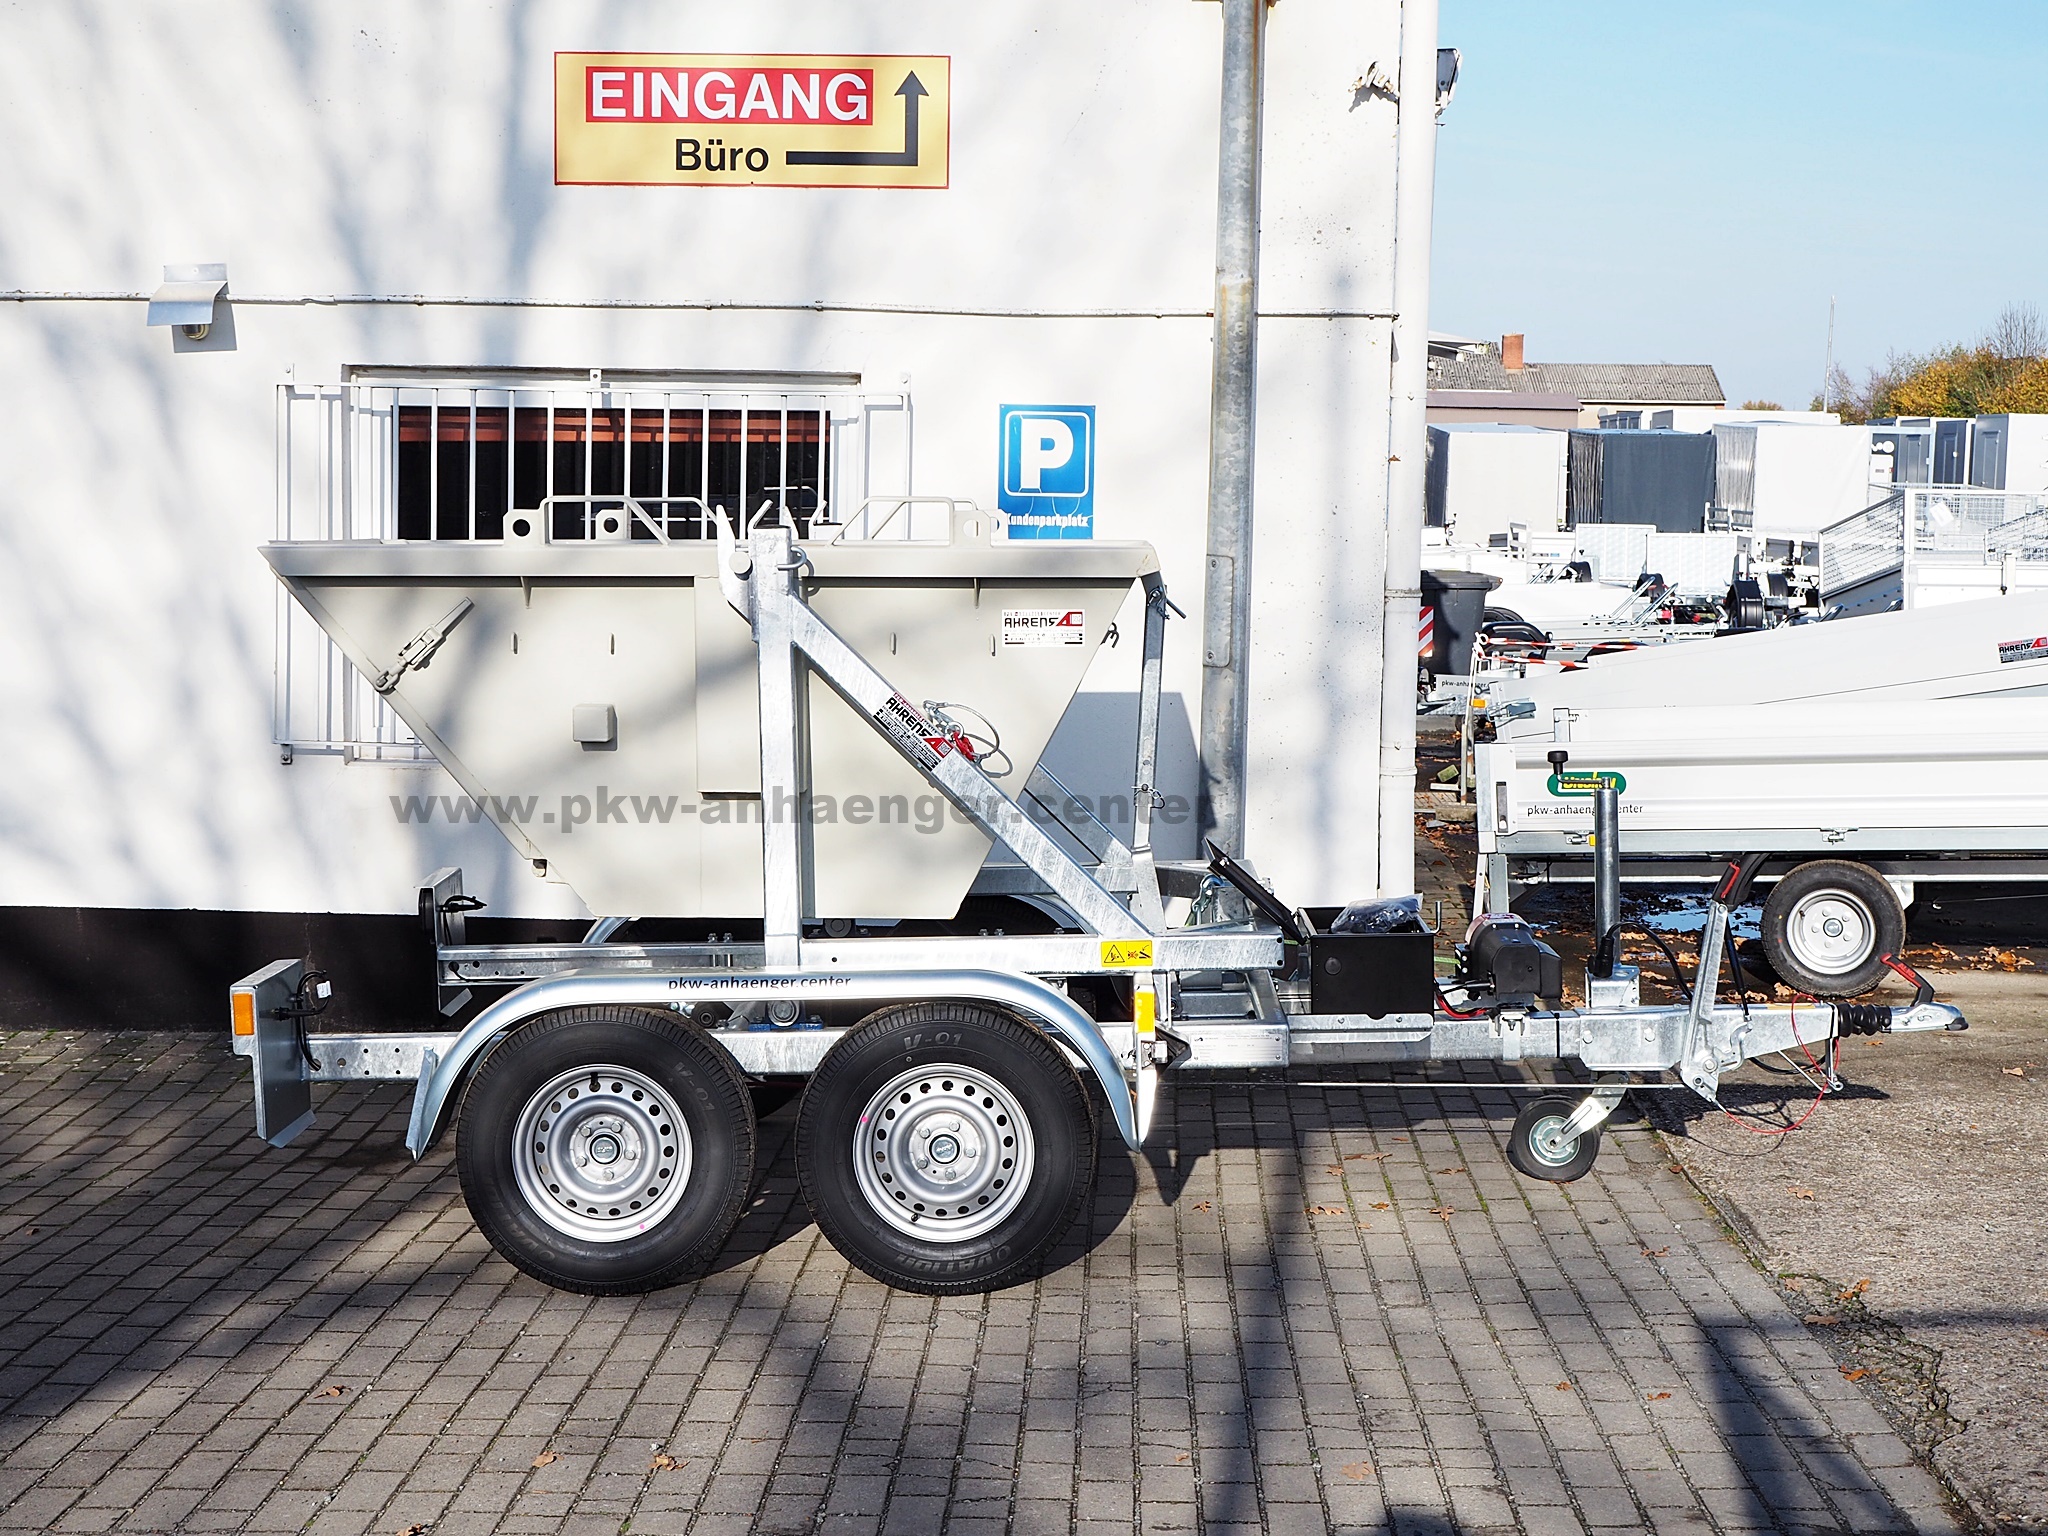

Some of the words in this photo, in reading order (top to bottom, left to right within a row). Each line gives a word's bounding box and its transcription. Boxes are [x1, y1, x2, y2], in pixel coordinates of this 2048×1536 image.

[592, 71, 867, 120] EINGANG
[676, 138, 769, 172] Büro
[1020, 418, 1074, 489] P
[1004, 617, 1059, 628] AHRENS
[1998, 642, 2033, 654] AHRENS
[884, 696, 933, 743] AHRENS
[668, 975, 851, 989] pkw-anhaenger.center
[903, 1032, 963, 1050] V-01
